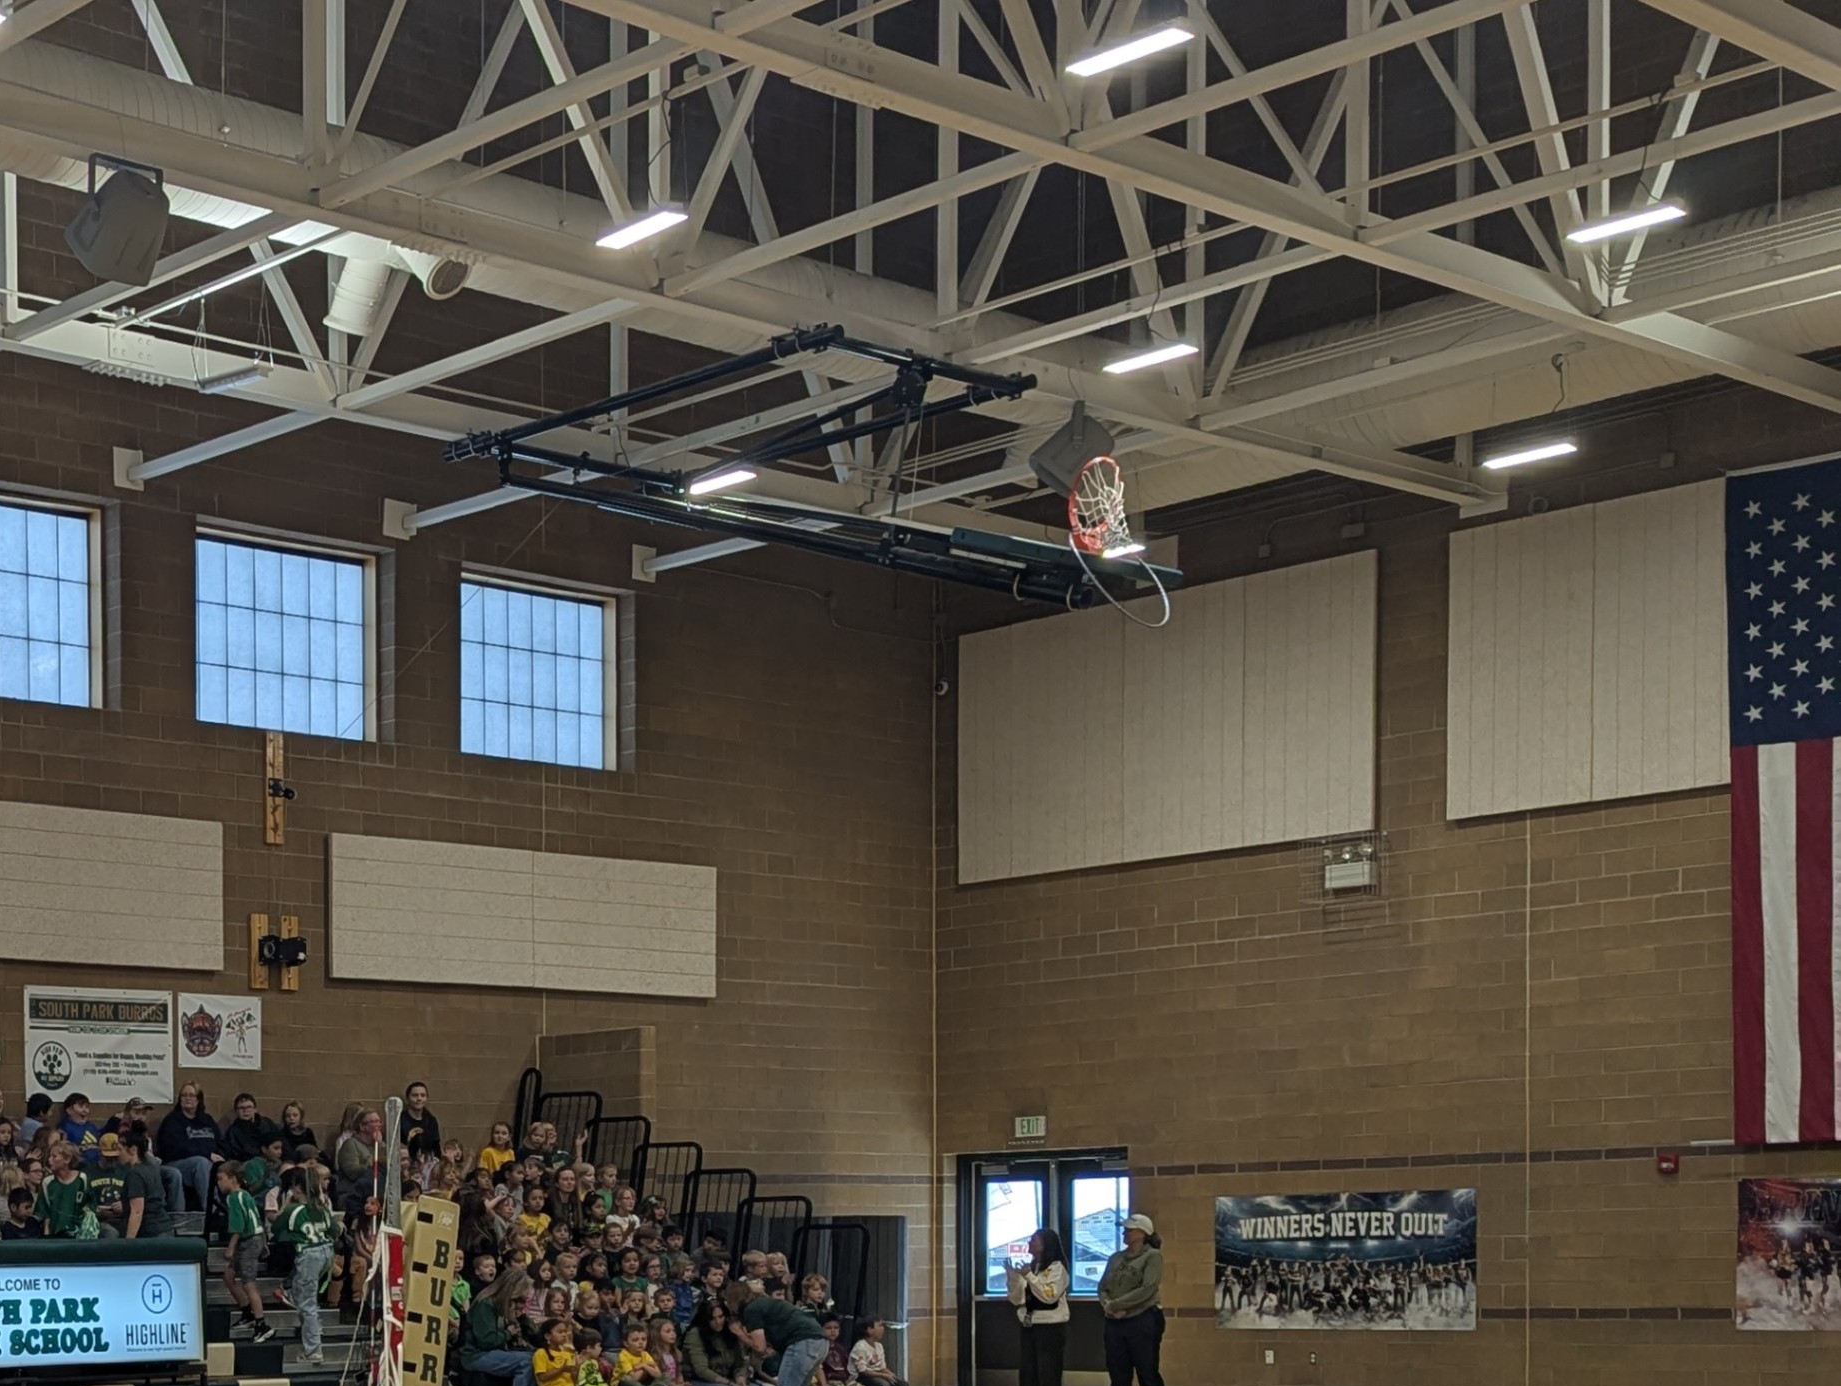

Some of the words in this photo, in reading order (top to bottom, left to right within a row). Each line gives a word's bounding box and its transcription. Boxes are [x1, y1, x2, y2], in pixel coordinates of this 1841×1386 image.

[39, 1001, 79, 1018] SOUTH
[82, 1003, 114, 1019] PARK
[119, 1004, 163, 1021] BURROS
[1020, 1118, 1039, 1134] EXIT
[1239, 1213, 1326, 1239] WINNERS
[1330, 1211, 1395, 1237] NEVER
[1401, 1212, 1448, 1236] QUIT
[44, 1278, 60, 1290] TO
[29, 1297, 100, 1324] PARK
[9, 1327, 109, 1355] SCHOOL
[126, 1323, 187, 1346] HIGHLINE
